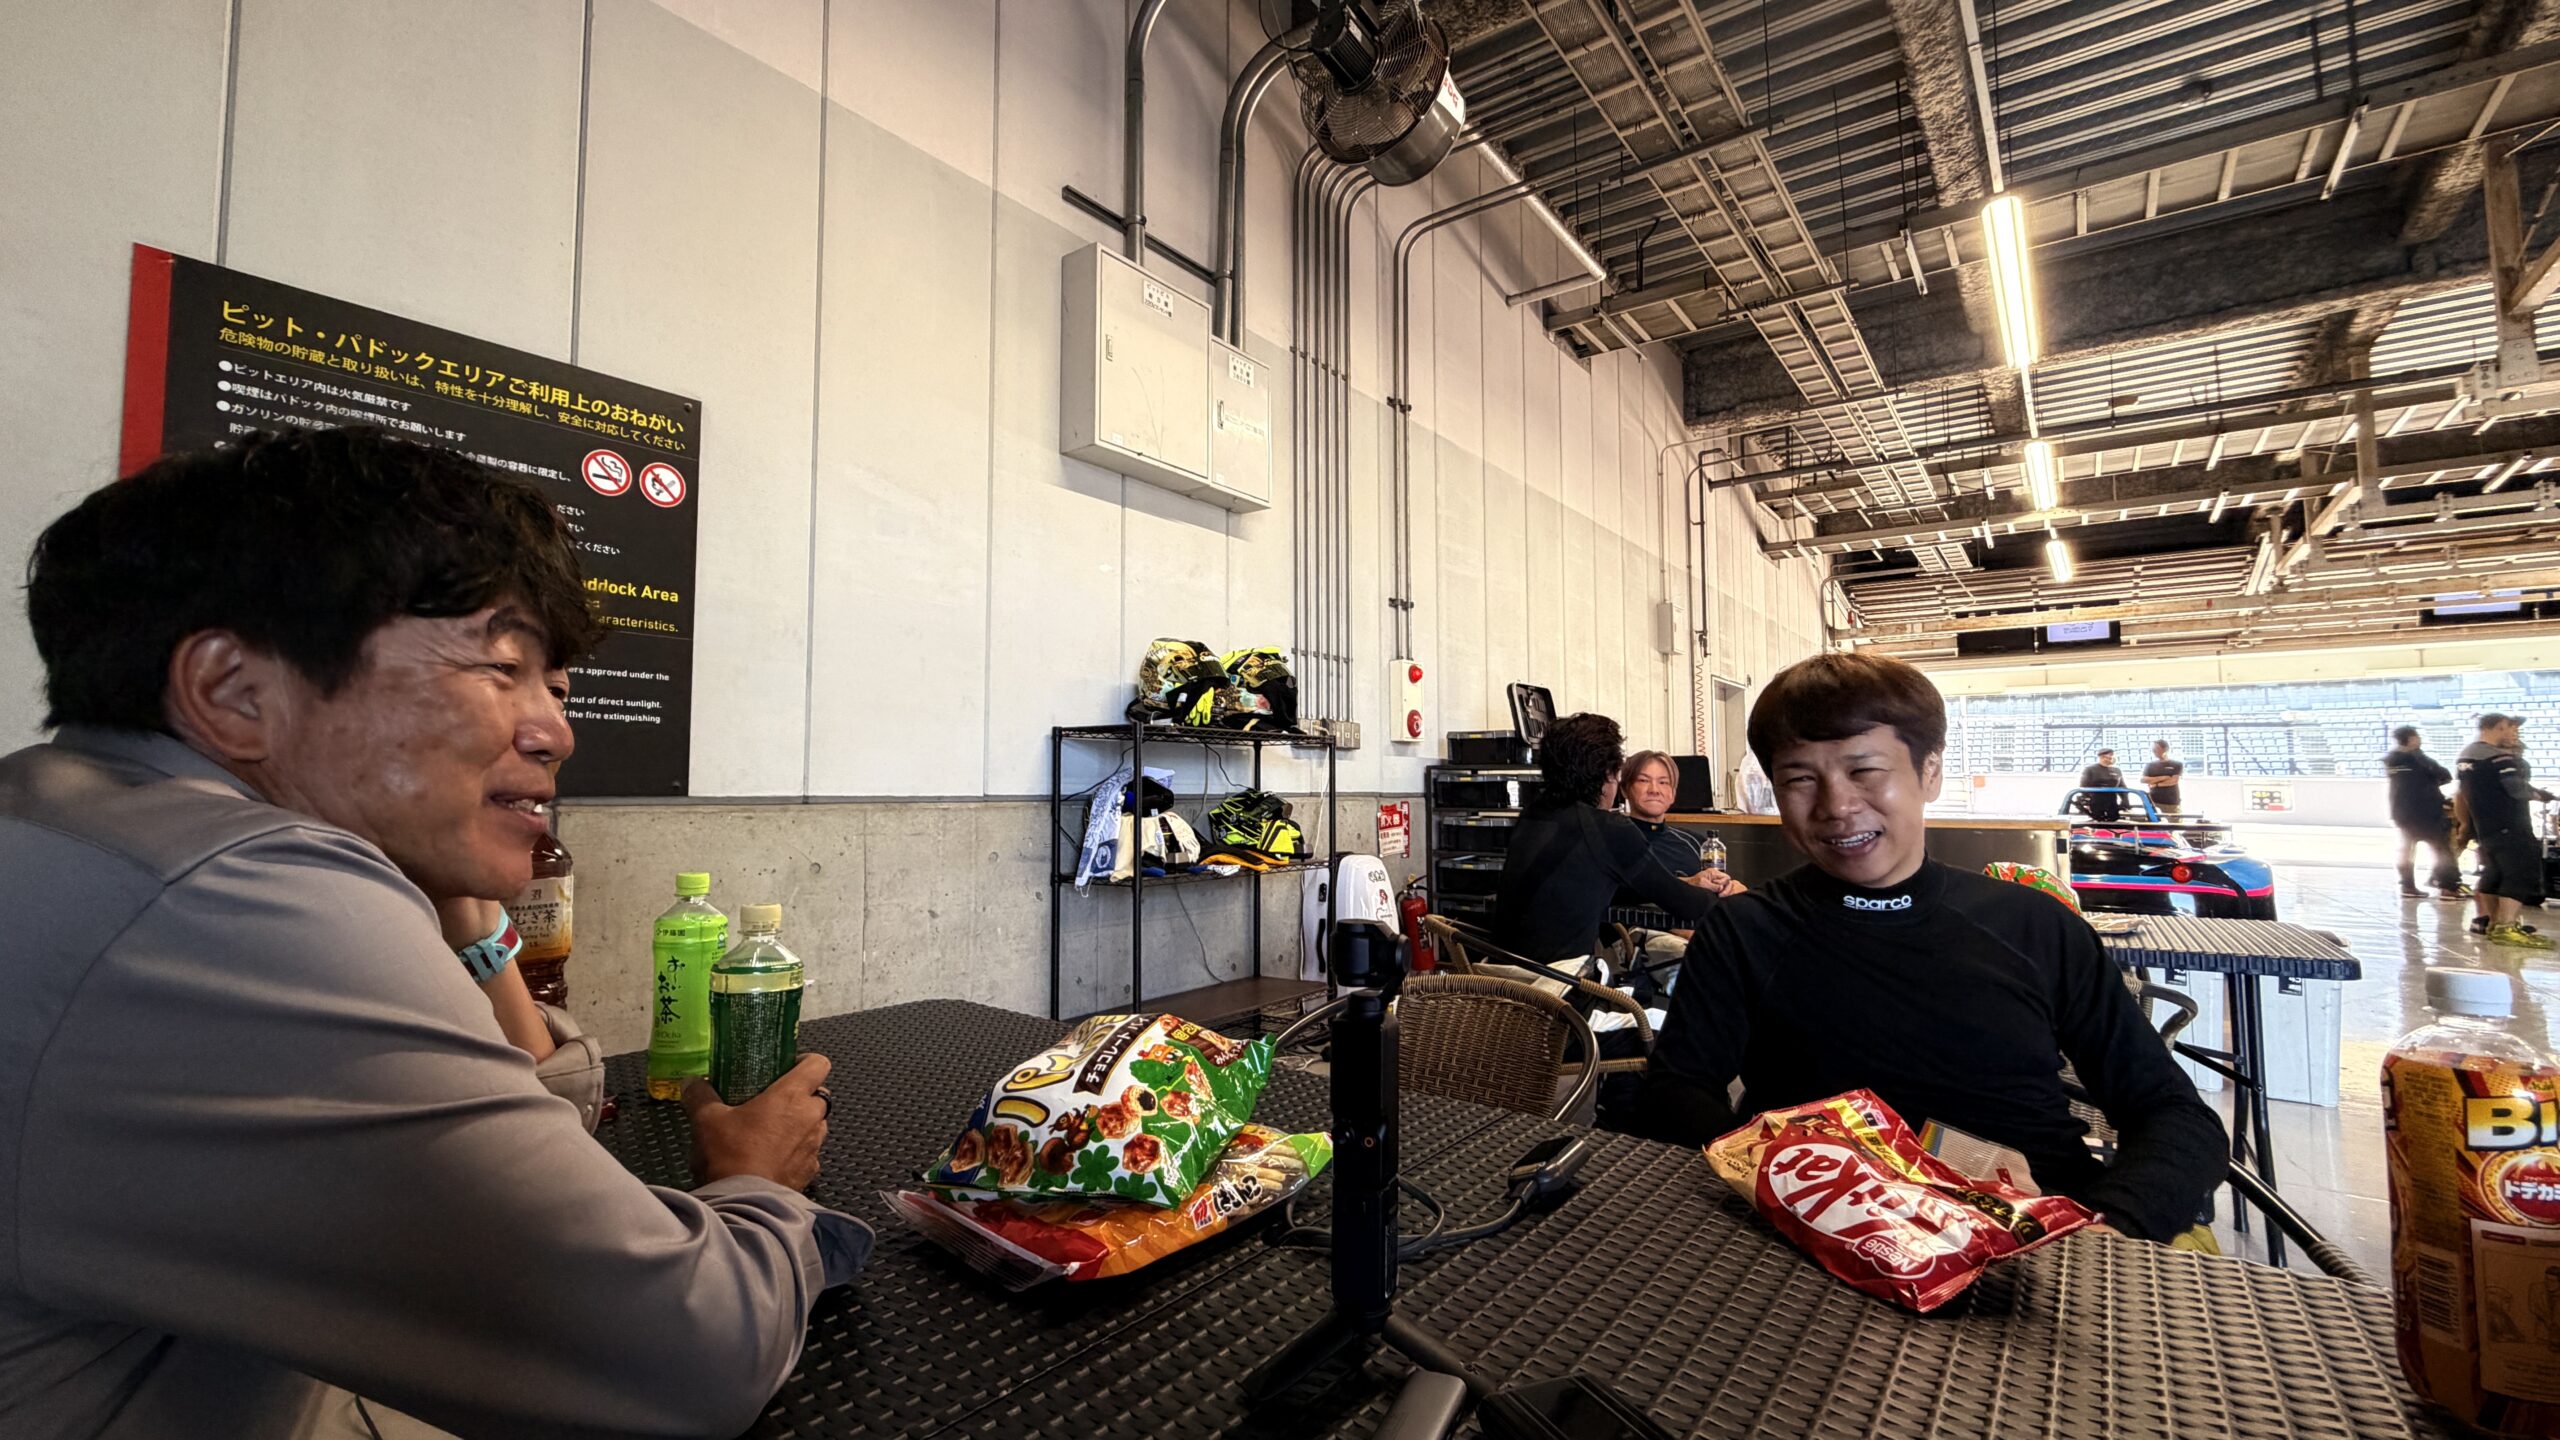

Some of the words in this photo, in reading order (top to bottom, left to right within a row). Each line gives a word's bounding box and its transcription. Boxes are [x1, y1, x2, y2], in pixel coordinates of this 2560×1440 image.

[222, 300, 684, 435] ピット・パドックエリアご利用上のおねがい
[234, 363, 412, 412] ピットエリア内は火気厳禁です
[556, 504, 585, 517] ださい
[641, 585, 680, 603] Area
[597, 614, 679, 632] aracteristics.
[568, 666, 584, 674] ers
[586, 667, 628, 678] approved
[629, 671, 654, 680] under
[656, 673, 670, 682] the
[570, 696, 585, 704] out
[587, 696, 596, 704] of
[598, 696, 624, 706] direct
[626, 699, 663, 709] sunlight.
[569, 710, 583, 719] the
[586, 711, 601, 719] fire
[604, 713, 661, 724] extinguishing
[1843, 895, 1912, 911] sparco
[1086, 1031, 1131, 1083] チョコレート
